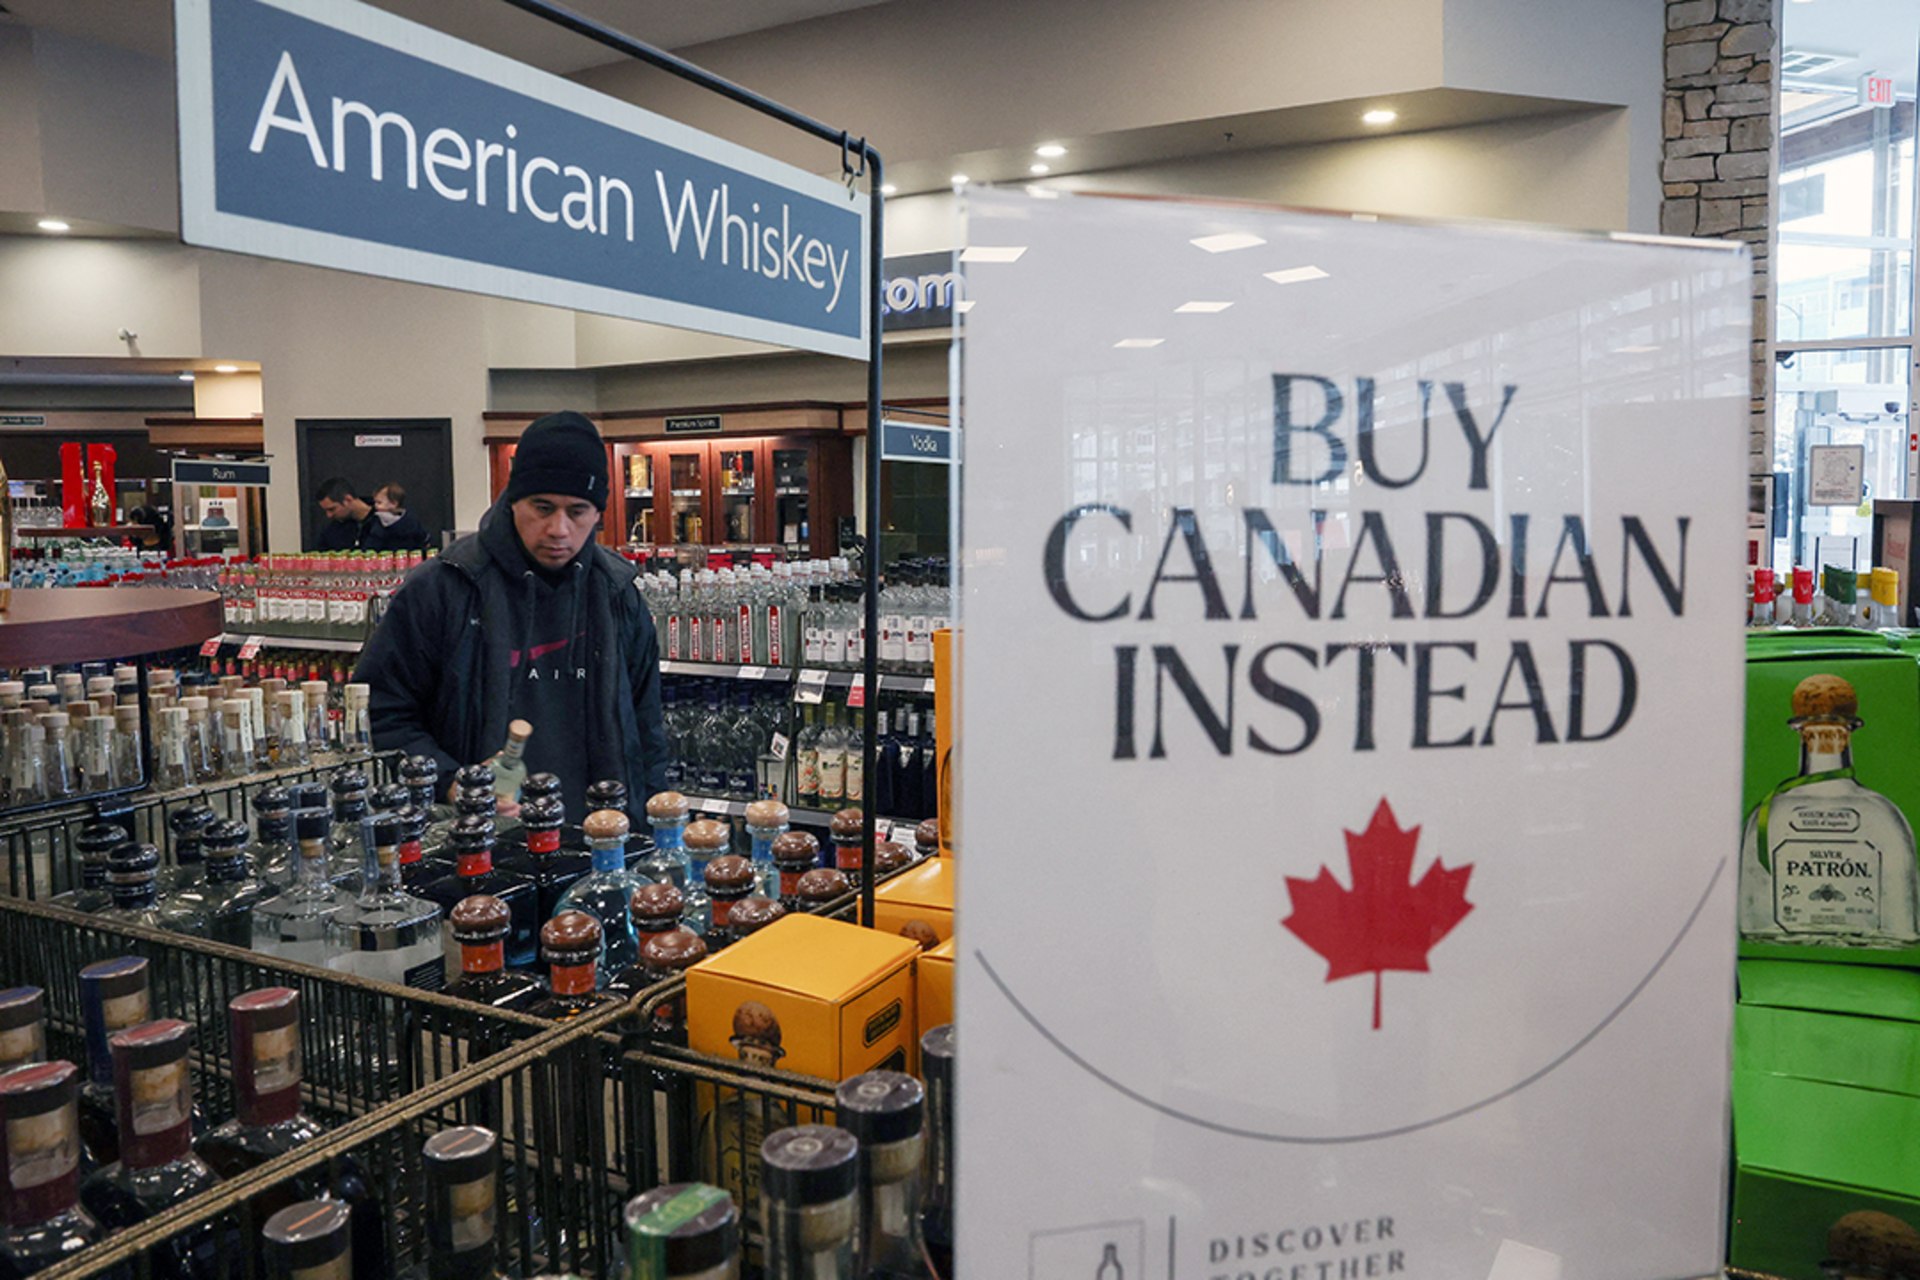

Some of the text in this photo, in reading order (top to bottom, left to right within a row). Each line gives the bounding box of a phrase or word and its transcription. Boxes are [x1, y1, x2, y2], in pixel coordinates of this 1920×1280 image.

[1868, 77, 1892, 105] EXIT
[248, 50, 850, 314] American Whiskey
[910, 434, 938, 453] Vodka
[1271, 372, 1518, 491] BUY
[212, 467, 236, 480] Rum
[1042, 505, 1692, 624] CANADIAN
[528, 667, 586, 680] AIR
[1111, 638, 1640, 762] INSTEAD
[1809, 850, 1843, 859] SILVER
[1209, 1215, 1396, 1265] DISCOVER
